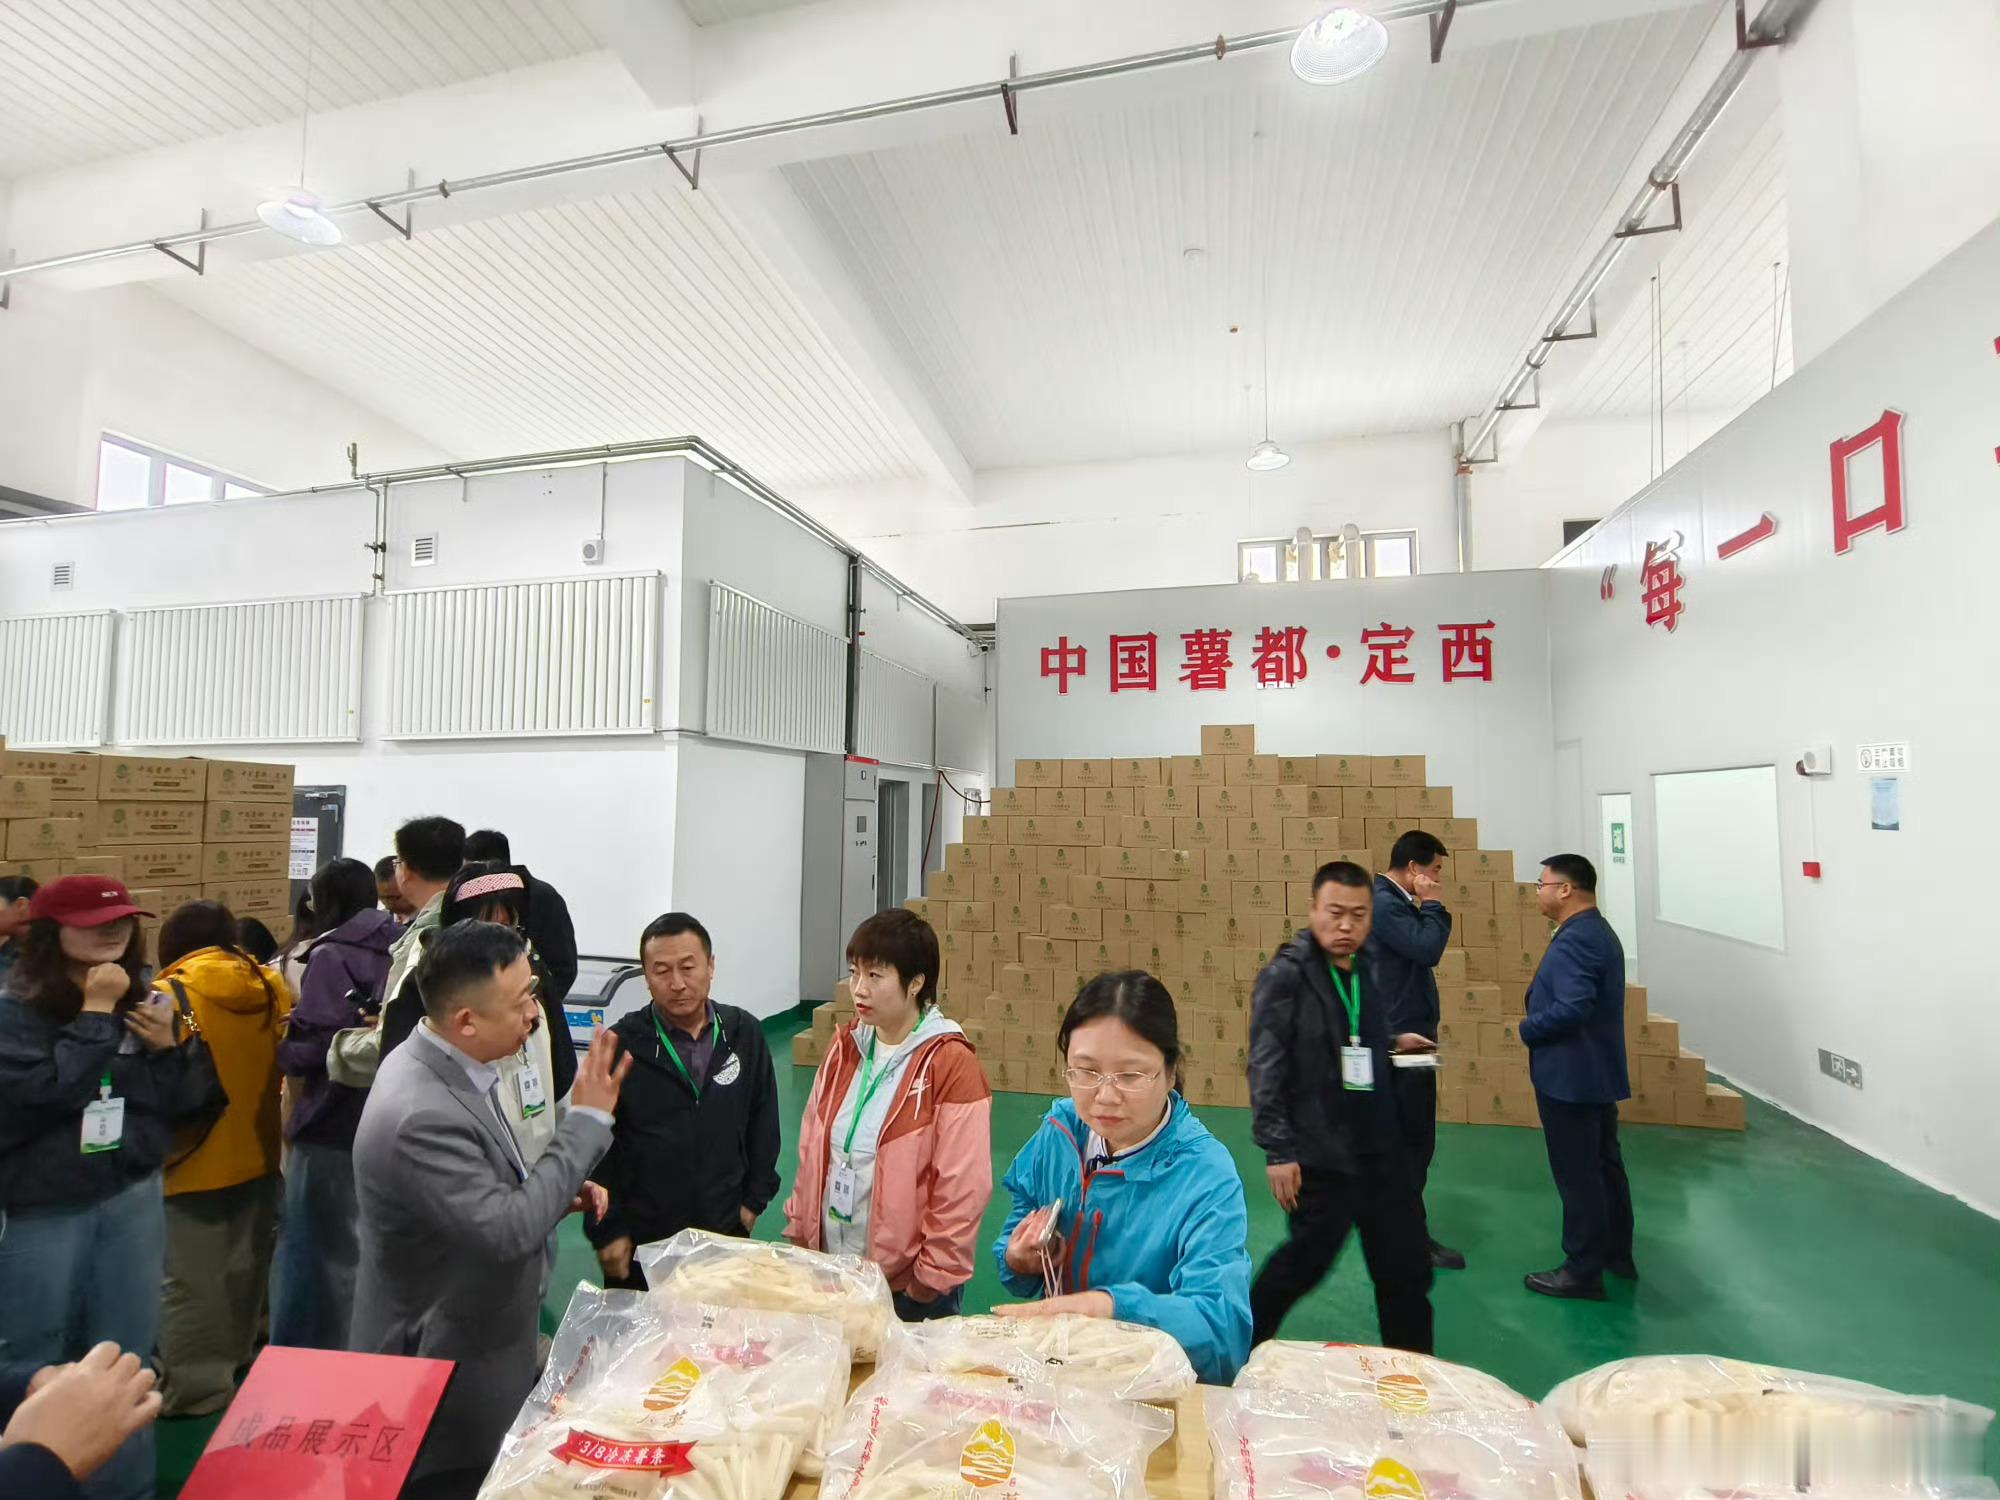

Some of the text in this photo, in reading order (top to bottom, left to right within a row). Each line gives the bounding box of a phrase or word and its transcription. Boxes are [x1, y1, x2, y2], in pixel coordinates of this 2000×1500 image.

[1040, 619, 1496, 696] 中国薯都·定西
[231, 1411, 405, 1462] 成品展示区
